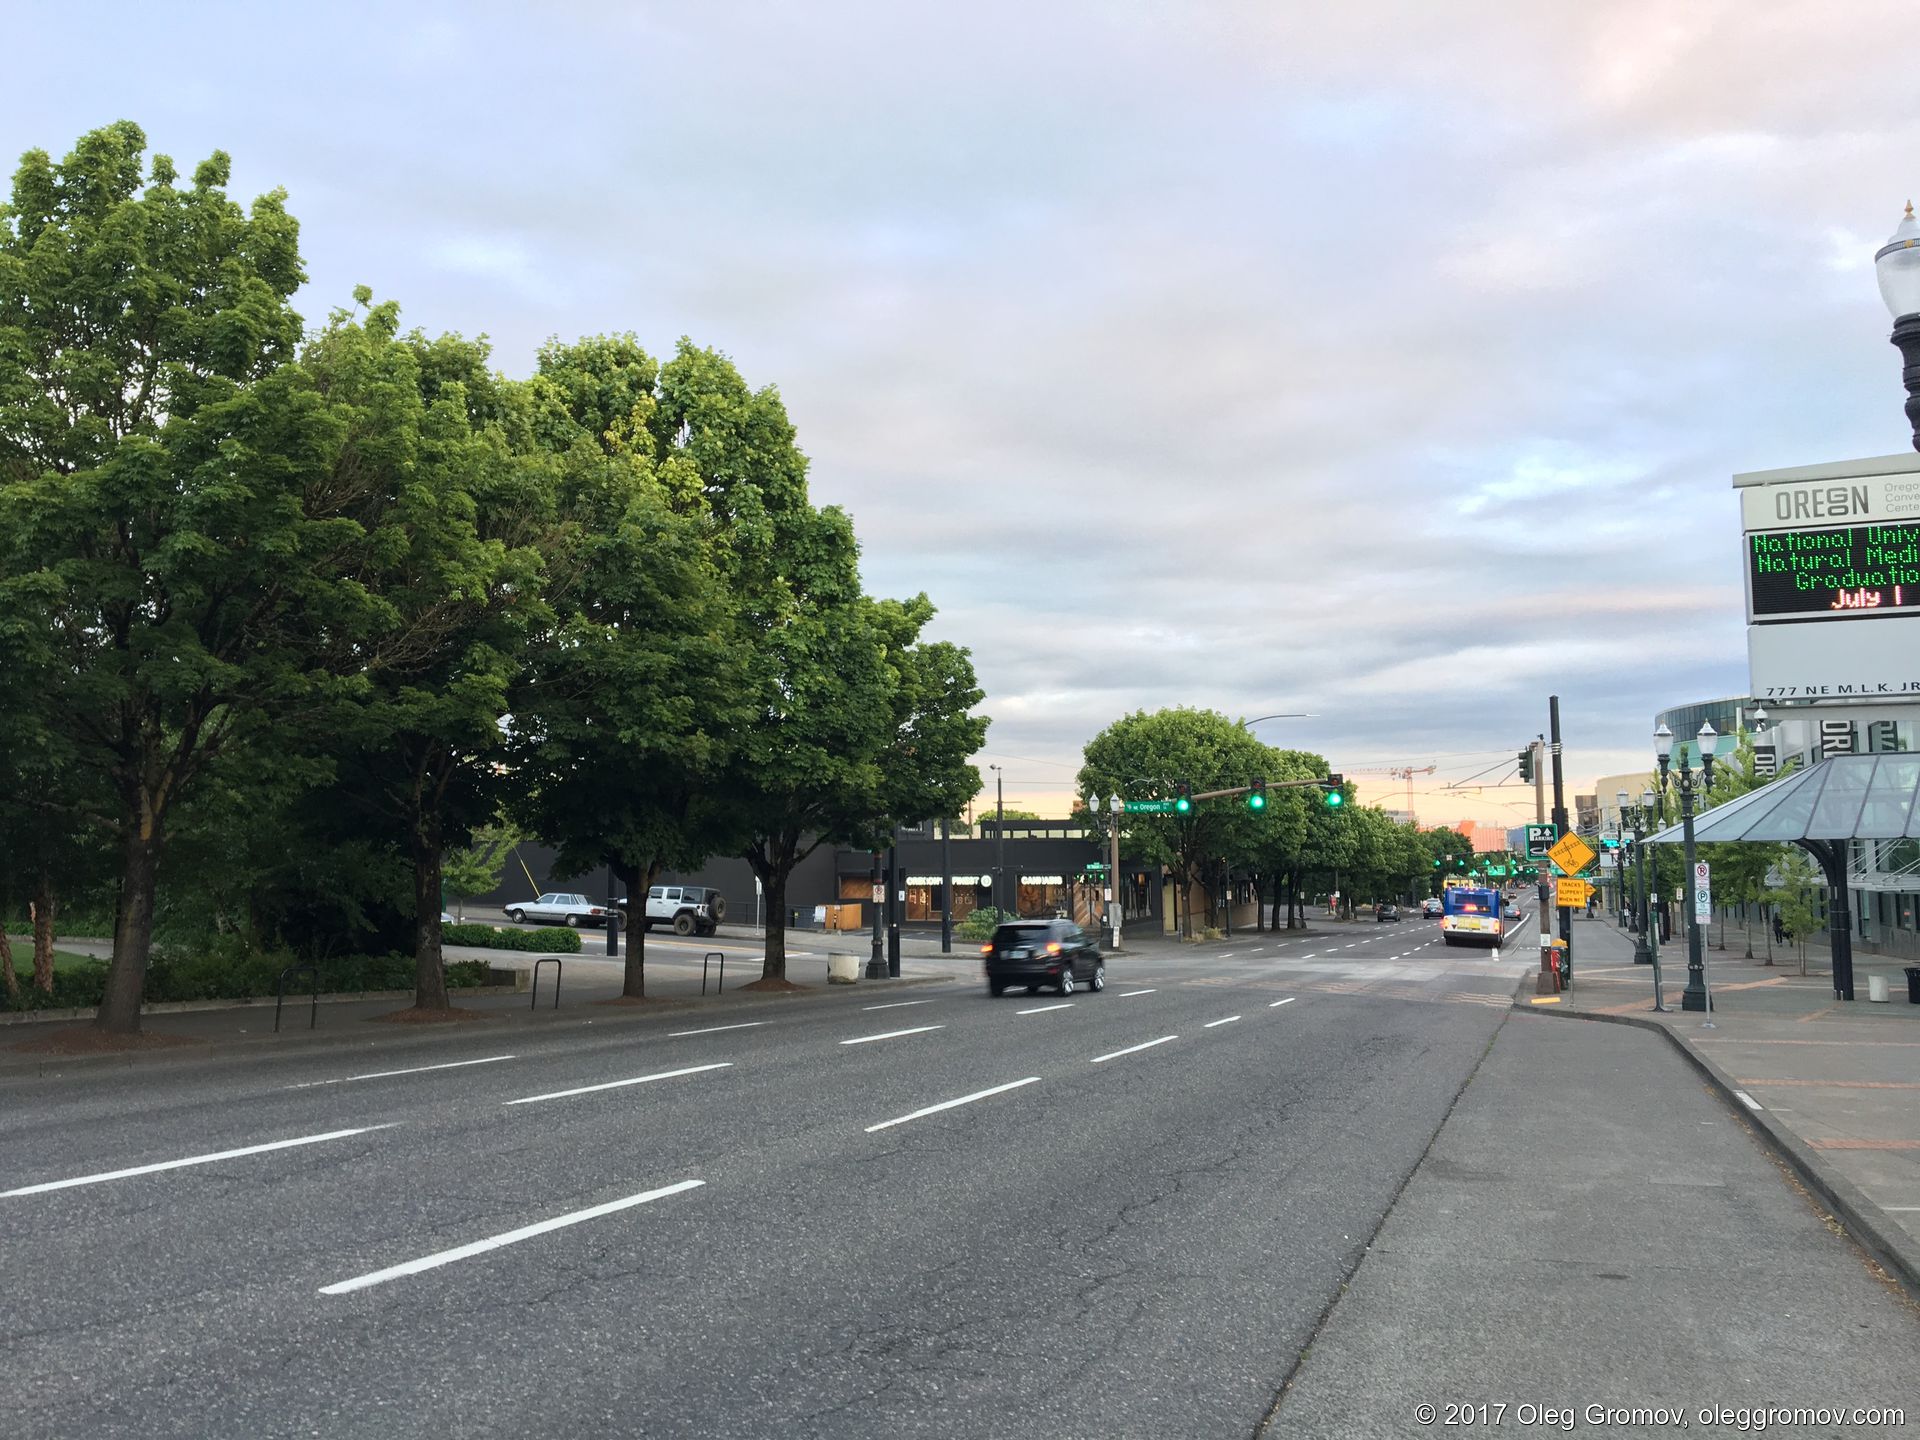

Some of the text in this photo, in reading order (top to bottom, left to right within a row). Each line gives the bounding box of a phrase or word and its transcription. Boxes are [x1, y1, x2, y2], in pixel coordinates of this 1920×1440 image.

[1775, 485, 1869, 520] OREGON
[1755, 524, 1919, 553] National Univ
[1758, 544, 1918, 573] Natural Medi
[1796, 565, 1919, 590] Graduatio
[1831, 585, 1902, 609] July 1
[1766, 687, 1797, 697] 777
[1806, 685, 1830, 695] NE
[1901, 681, 1920, 692] JR
[1140, 803, 1160, 812] Oregon
[1021, 875, 1063, 886] CANNABIS
